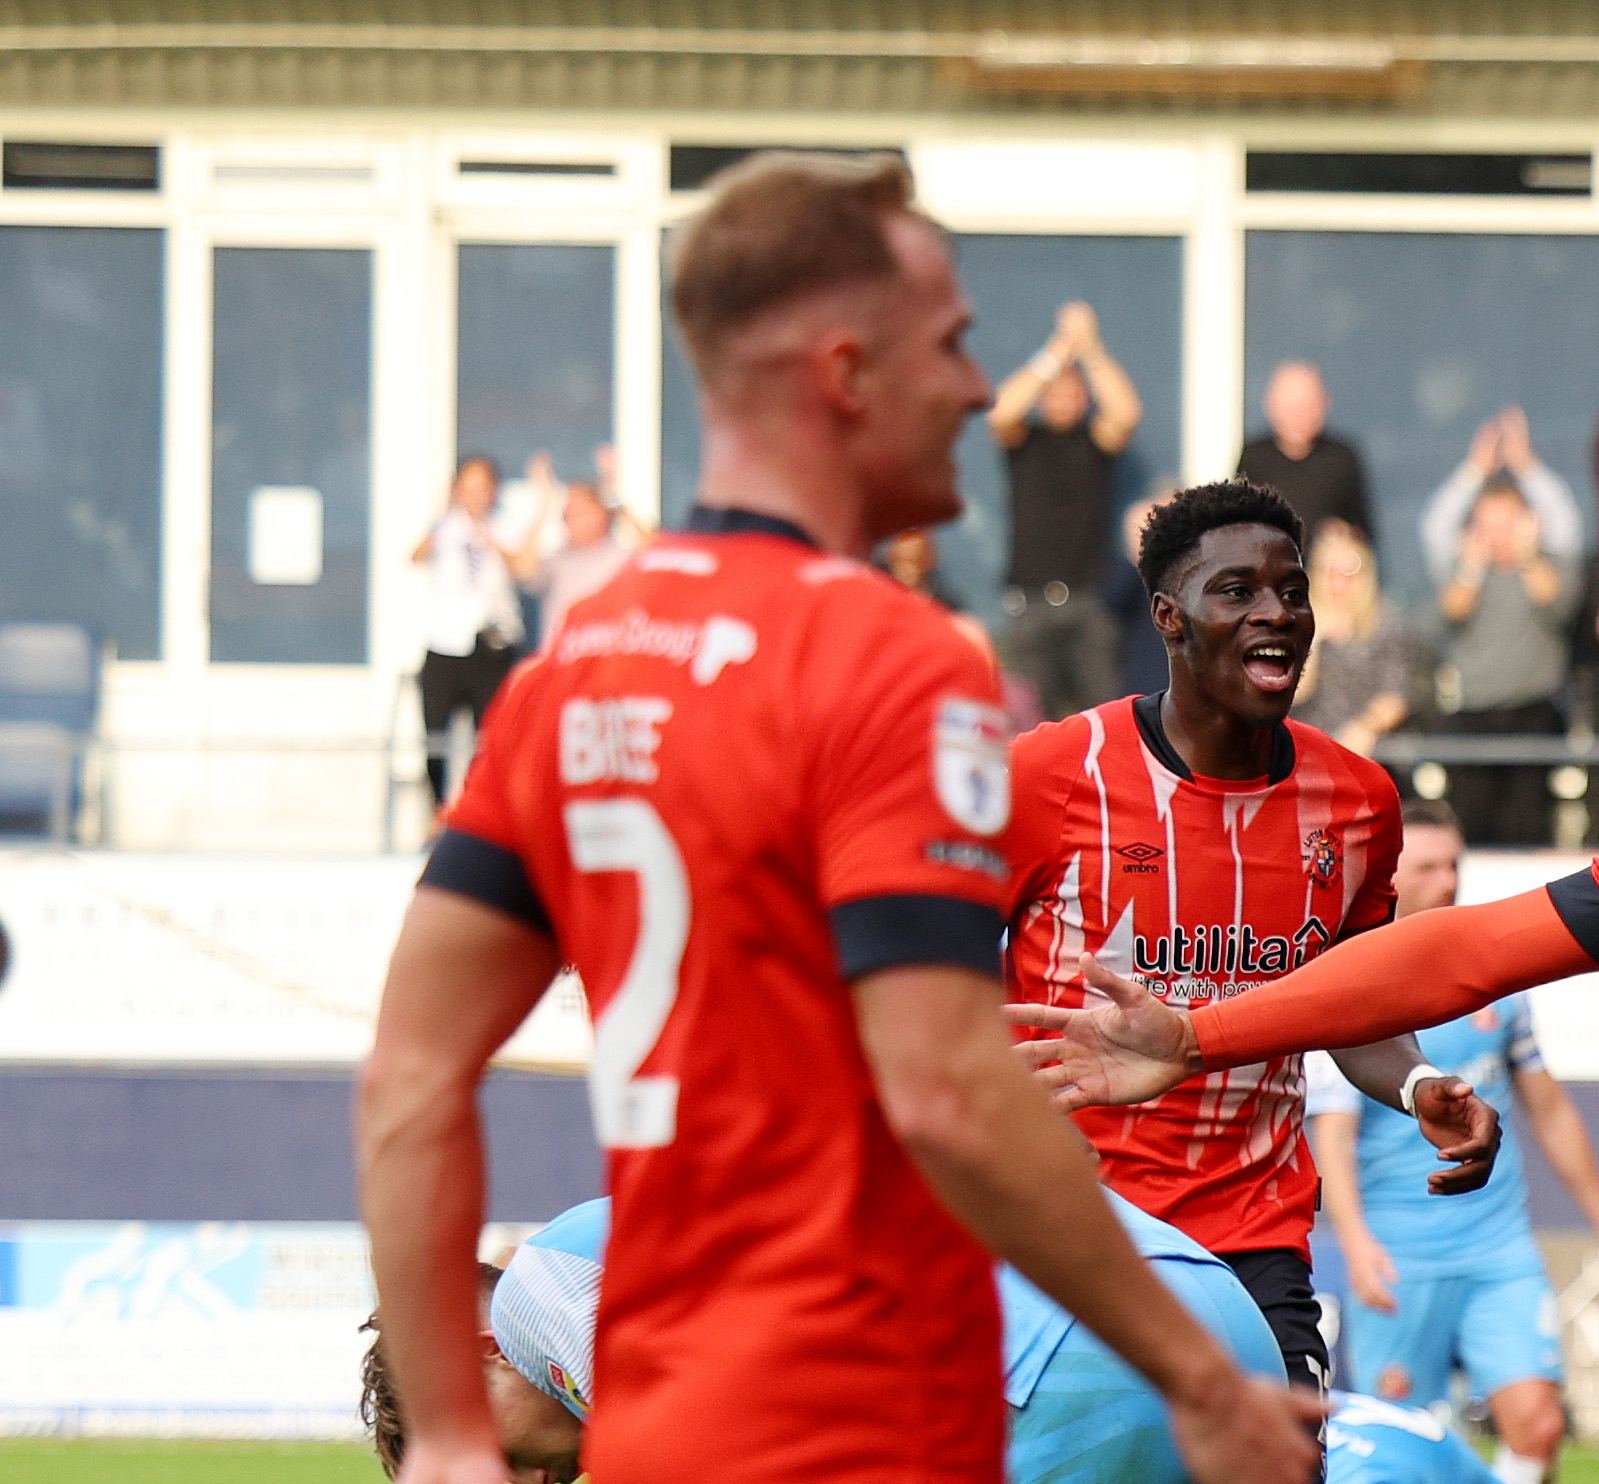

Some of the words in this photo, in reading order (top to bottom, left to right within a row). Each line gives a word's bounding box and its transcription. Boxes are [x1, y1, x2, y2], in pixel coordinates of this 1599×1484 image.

[1123, 863, 1159, 873] umbro
[1134, 924, 1290, 974] utilita
[563, 799, 692, 1150] 2
[1172, 975, 1218, 998] with
